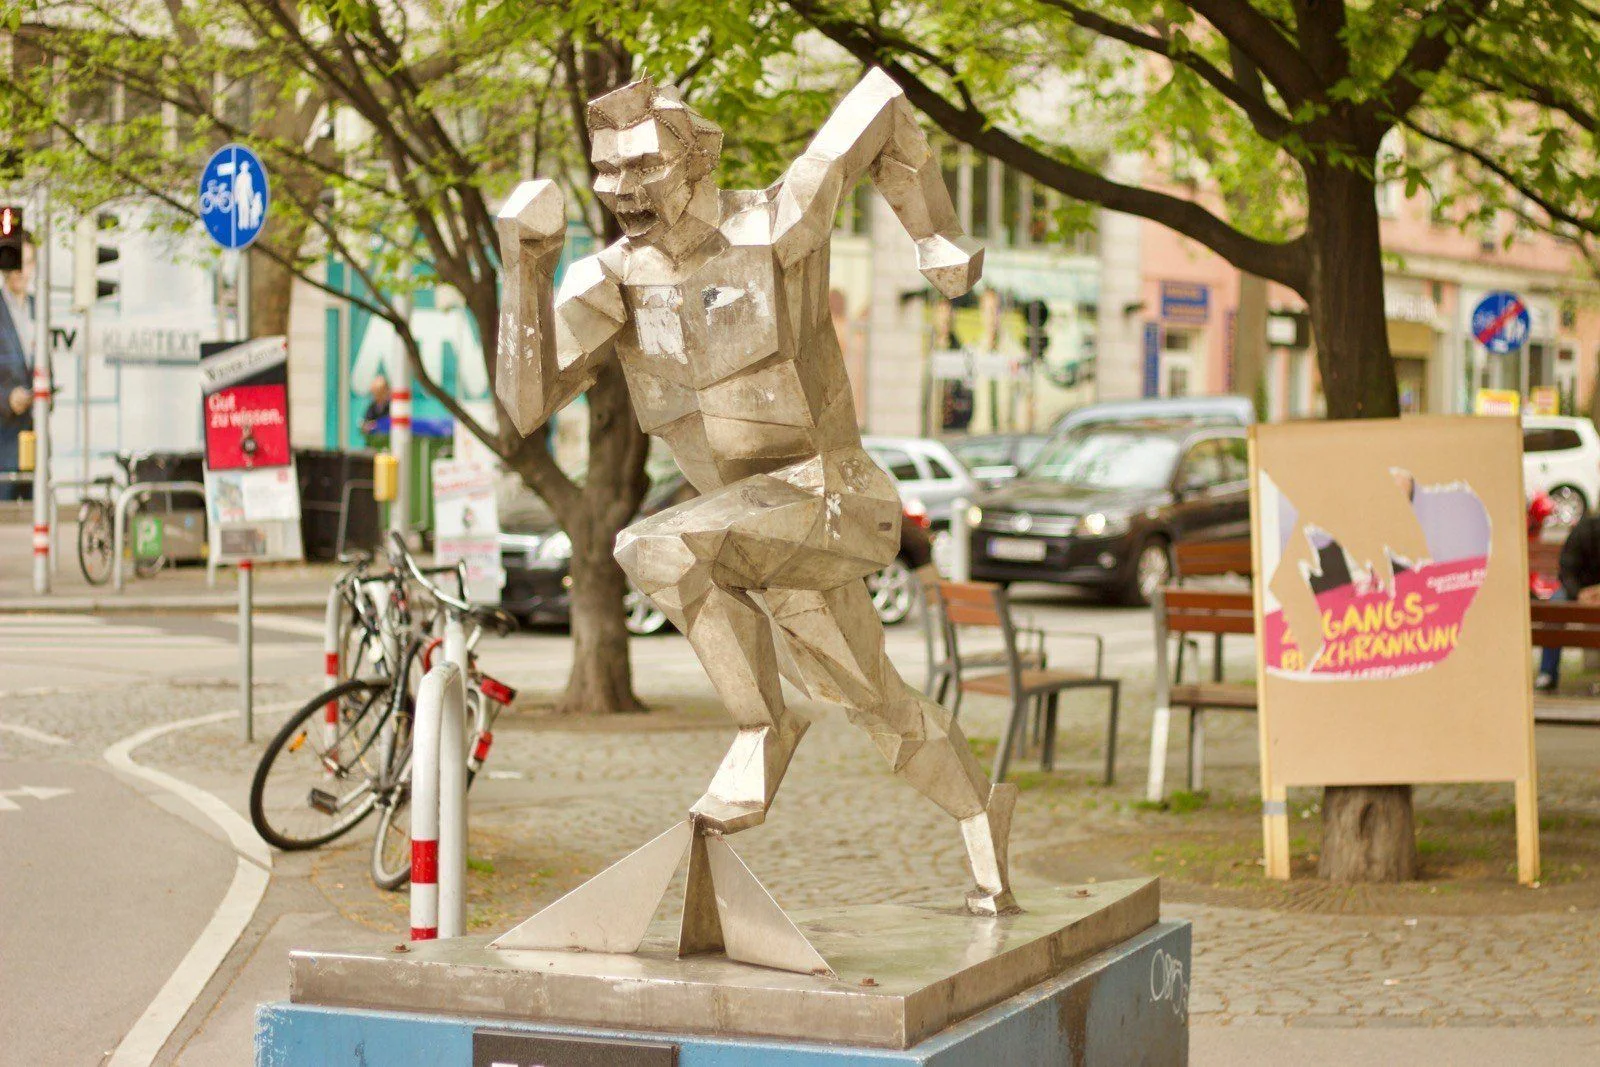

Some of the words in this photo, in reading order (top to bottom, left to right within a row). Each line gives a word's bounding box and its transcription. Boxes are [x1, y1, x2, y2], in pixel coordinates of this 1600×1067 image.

[208, 392, 236, 412] Gut
[211, 412, 229, 428] zu
[1281, 592, 1440, 645] GANGS-
